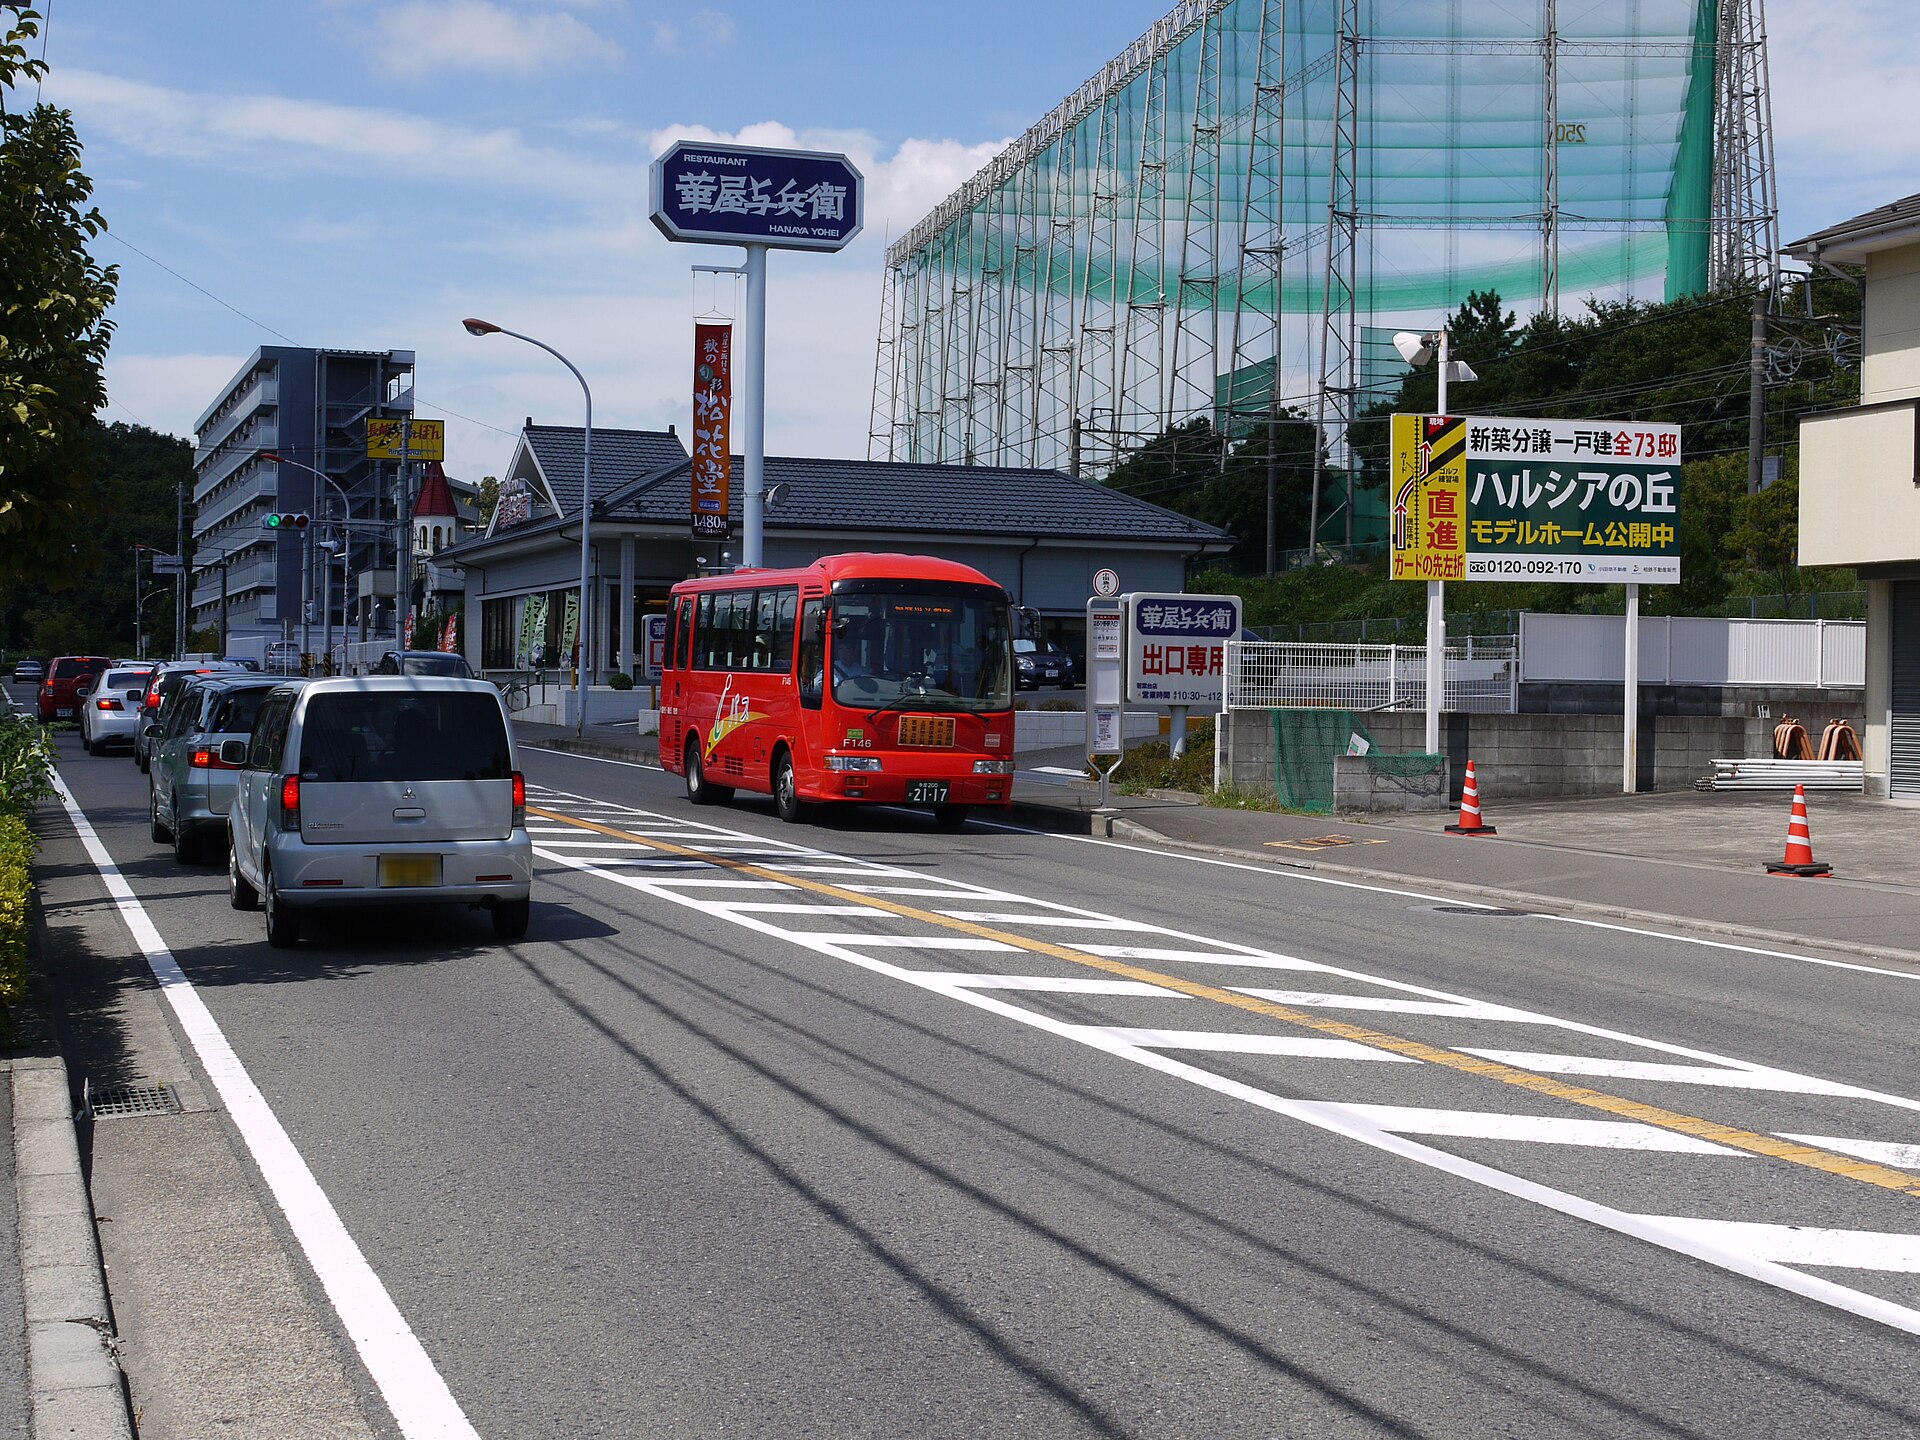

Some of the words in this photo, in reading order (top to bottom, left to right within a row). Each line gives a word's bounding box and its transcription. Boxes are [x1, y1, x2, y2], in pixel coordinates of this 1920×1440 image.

[683, 154, 748, 167] RESTAURANT
[675, 170, 847, 221] 華屋与兵衛
[769, 224, 809, 235] HANAYA
[811, 227, 840, 237] YOHEI
[1429, 417, 1444, 426] 現地
[1400, 451, 1408, 474] ガード
[1439, 468, 1459, 476] ゴルフ
[1438, 475, 1460, 484] 練習場
[1470, 469, 1676, 514] ハルシアの丘
[1406, 518, 1414, 540] 現在地
[1427, 489, 1458, 550] 直進
[1470, 519, 1674, 549] モデルホーム公開中
[1395, 553, 1464, 579] ガードの先左折
[1487, 560, 1582, 576] 0120-092-170
[1141, 605, 1232, 630] 華屋与兵衛
[843, 738, 872, 748] F146
